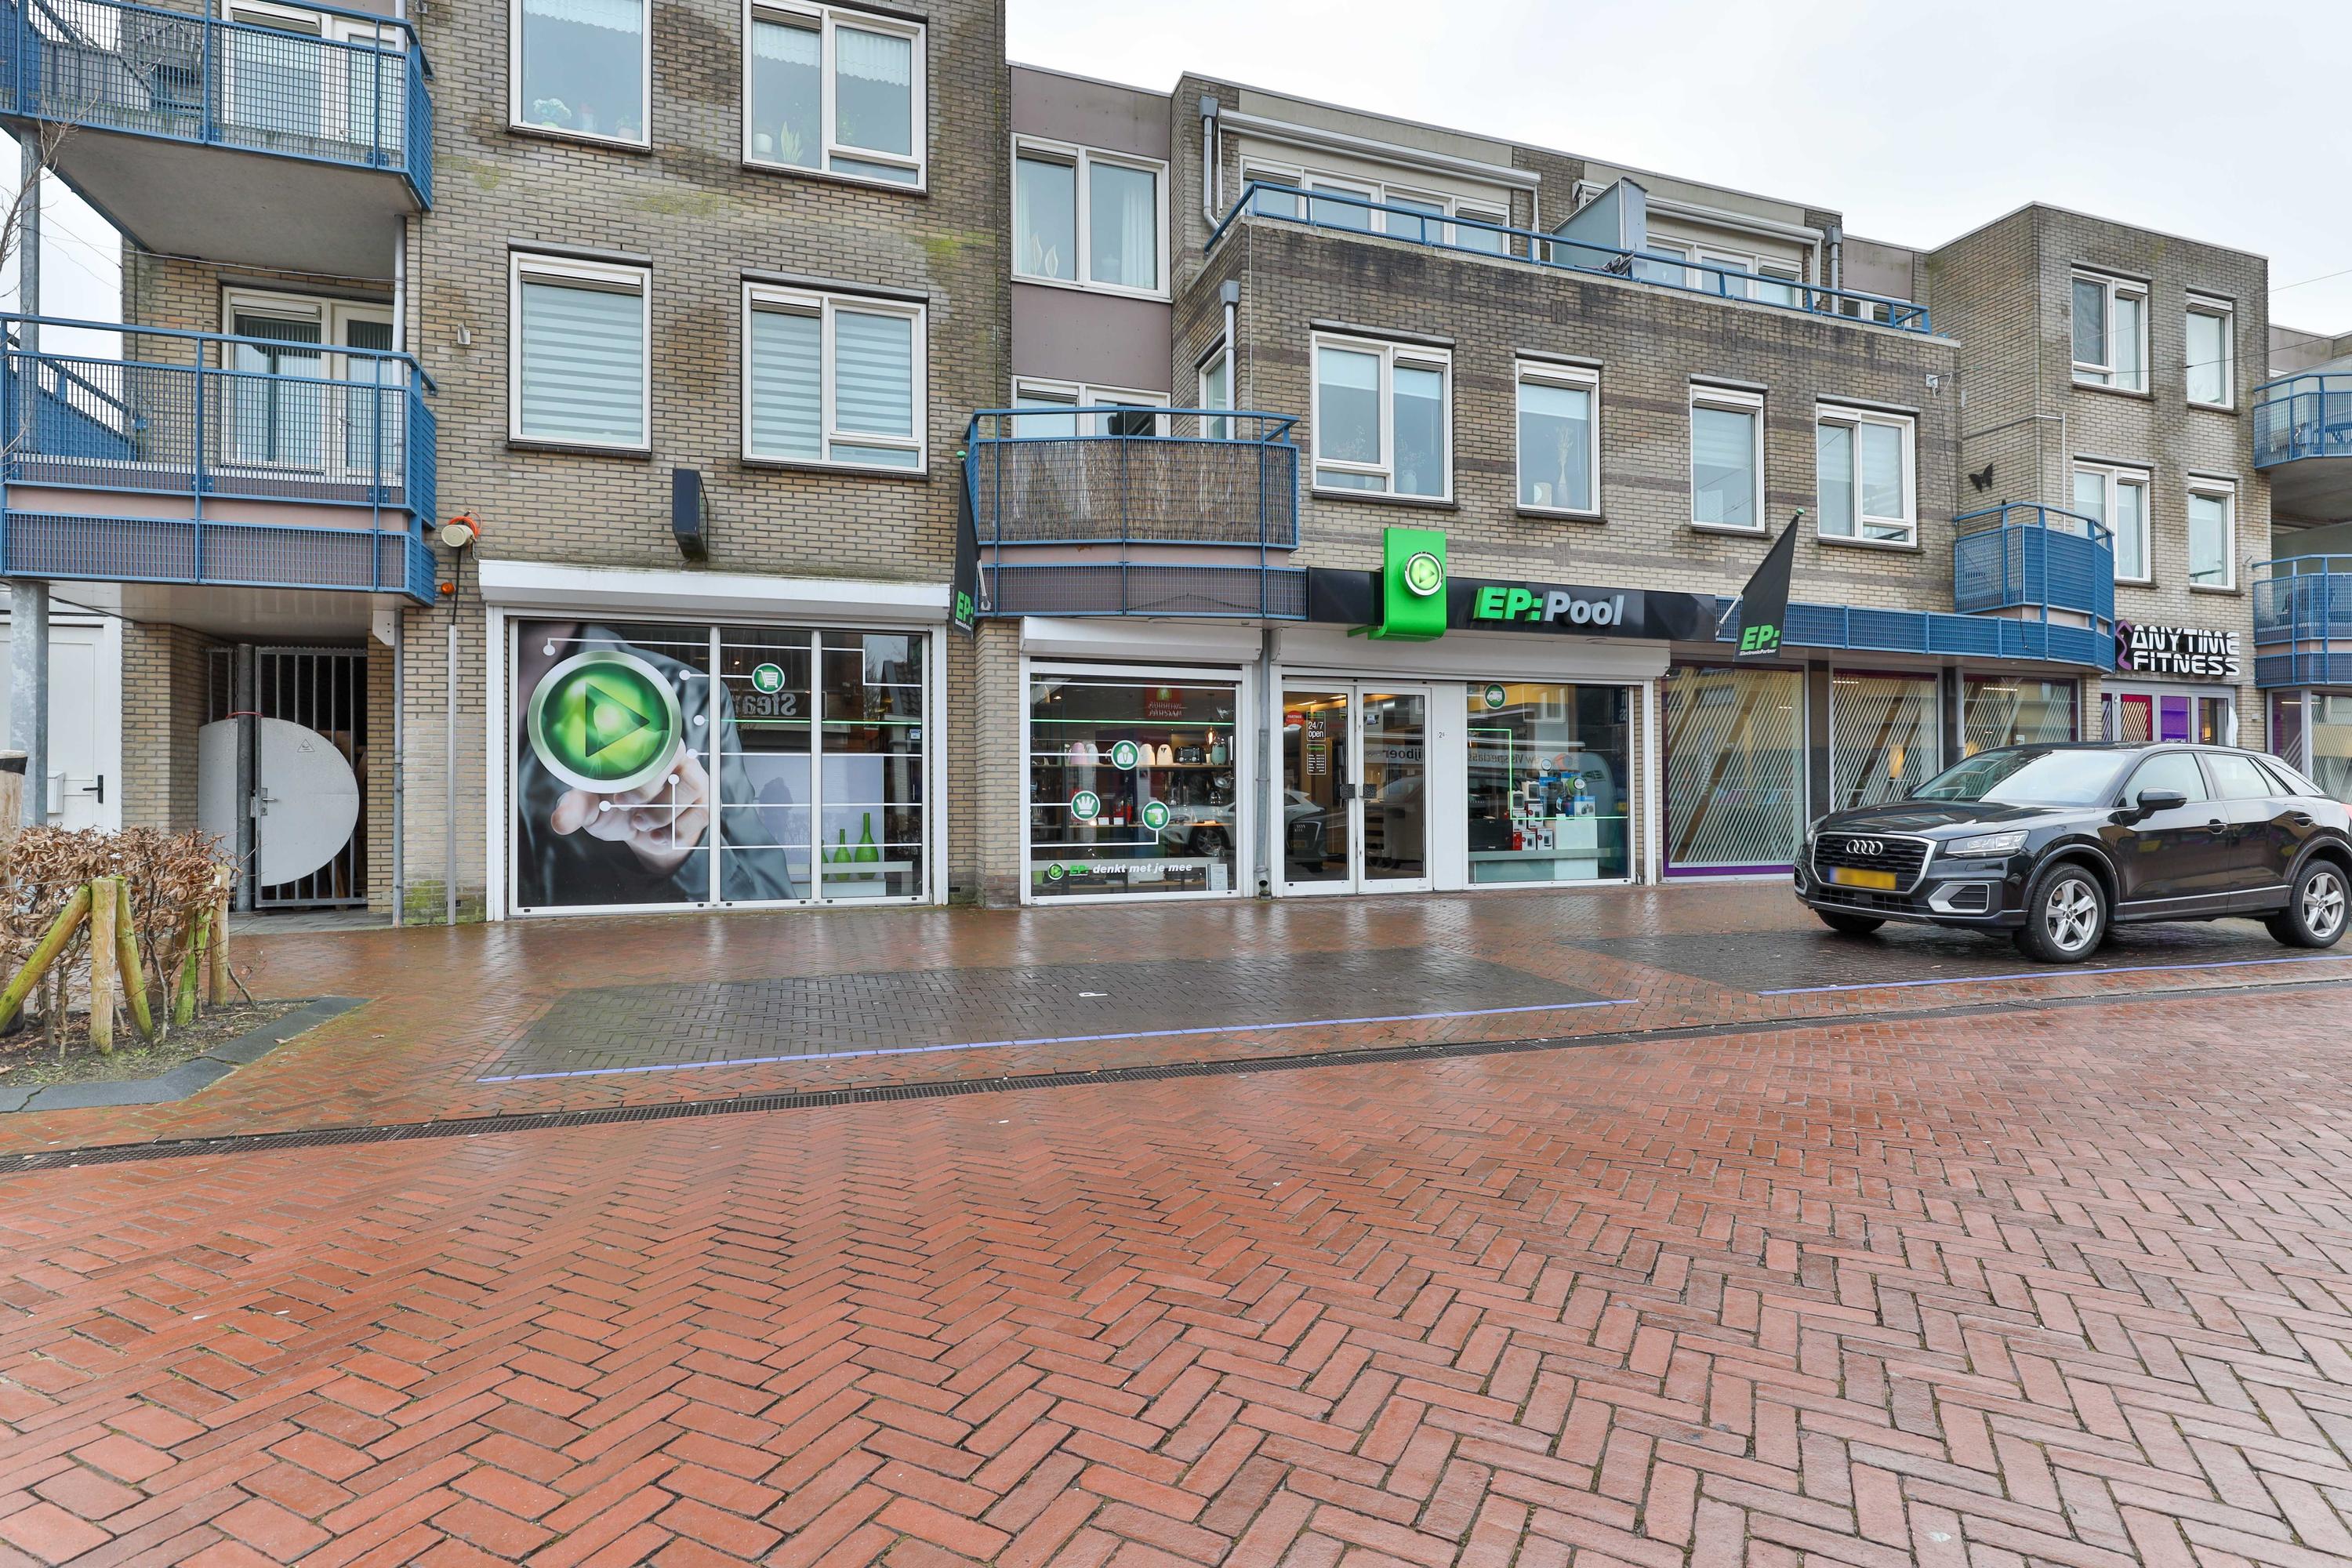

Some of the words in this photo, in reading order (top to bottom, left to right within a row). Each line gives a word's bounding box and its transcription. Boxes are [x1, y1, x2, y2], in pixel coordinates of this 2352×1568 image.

[956, 590, 974, 625] EP:
[1474, 586, 1624, 625] EP:Pool
[1740, 624, 1780, 651] EP:
[2131, 624, 2240, 655] ANYTIME
[2133, 651, 2240, 677] FITNESS
[1308, 721, 1323, 730] 24/7
[1308, 731, 1324, 739] open
[1069, 865, 1089, 875] EP:
[1093, 864, 1126, 873] denkt
[1129, 864, 1152, 873] met
[1154, 863, 1165, 873] je
[1167, 863, 1192, 872] mee
